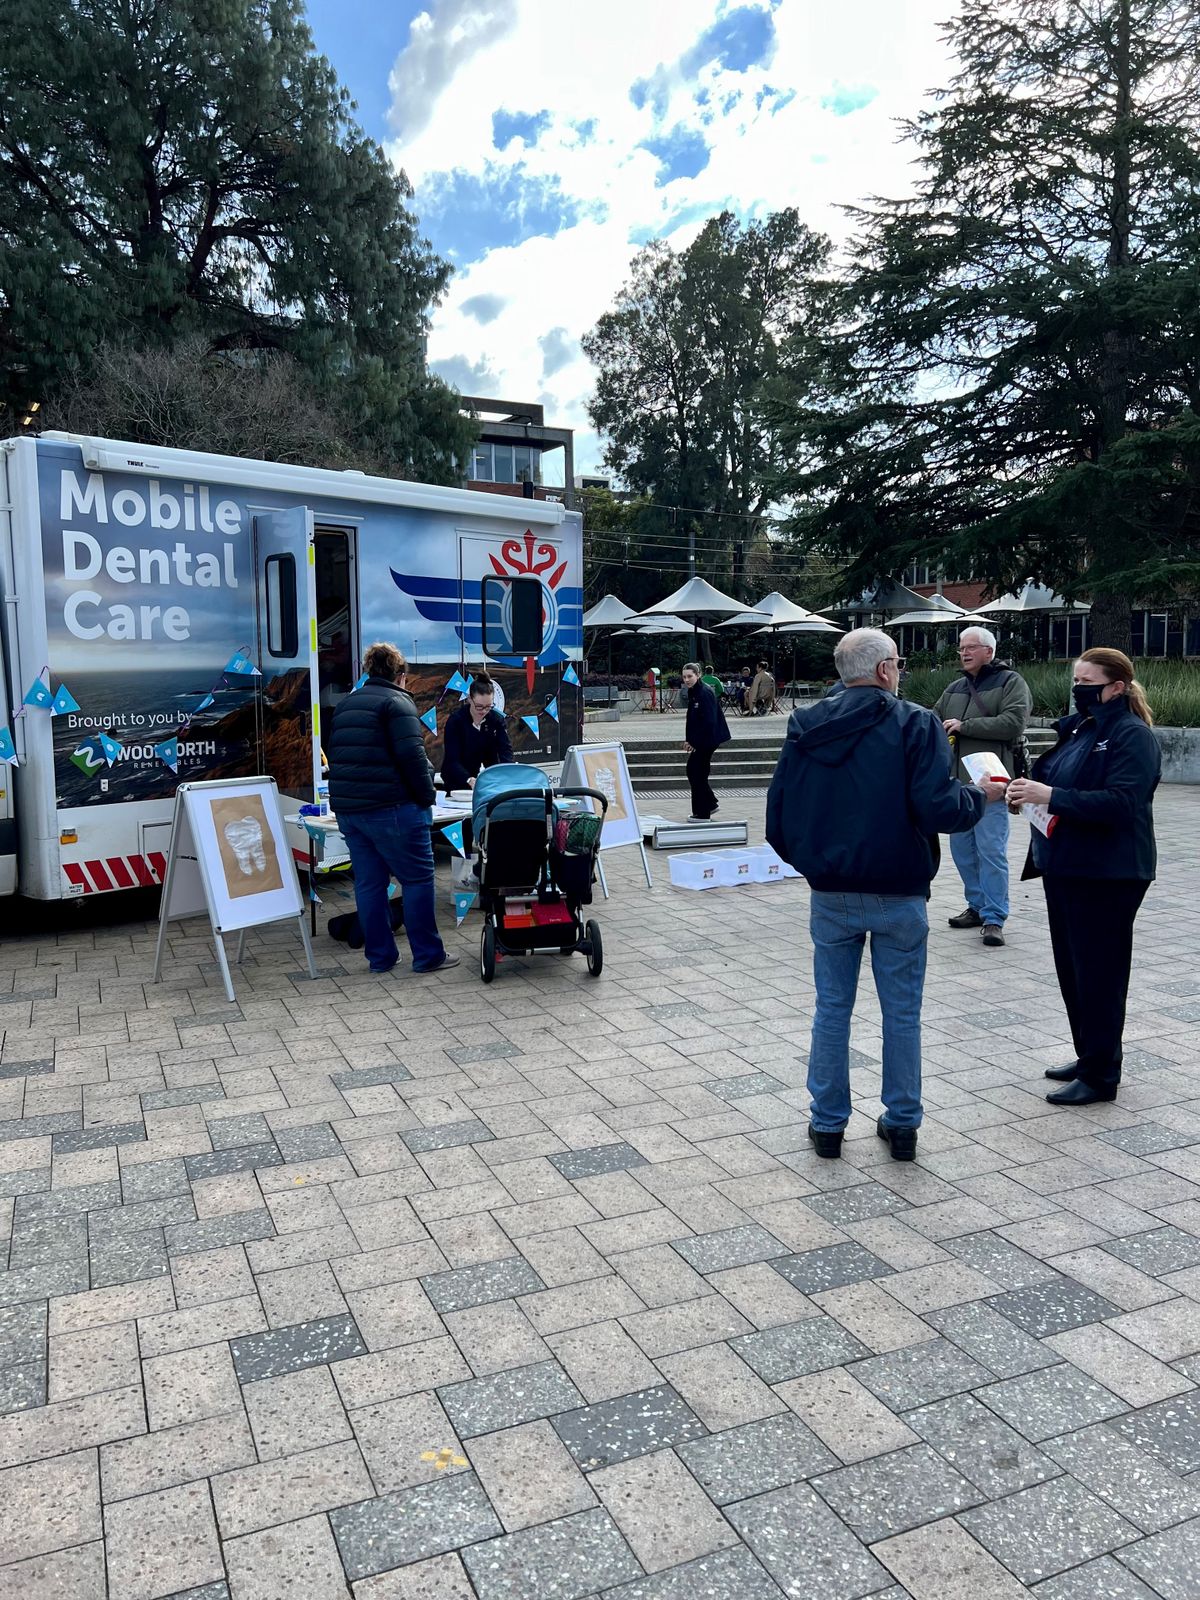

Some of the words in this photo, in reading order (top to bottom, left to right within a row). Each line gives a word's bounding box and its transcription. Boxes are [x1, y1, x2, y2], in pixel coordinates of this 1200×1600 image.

[60, 469, 242, 535] Mobile
[62, 530, 238, 588] Dental
[63, 590, 190, 641] Care
[68, 712, 127, 730] Brought
[131, 714, 145, 725] to
[148, 713, 173, 728] you
[177, 710, 193, 726] by
[117, 740, 216, 761] WOOLORTH
[133, 758, 202, 769] RENEBLES
